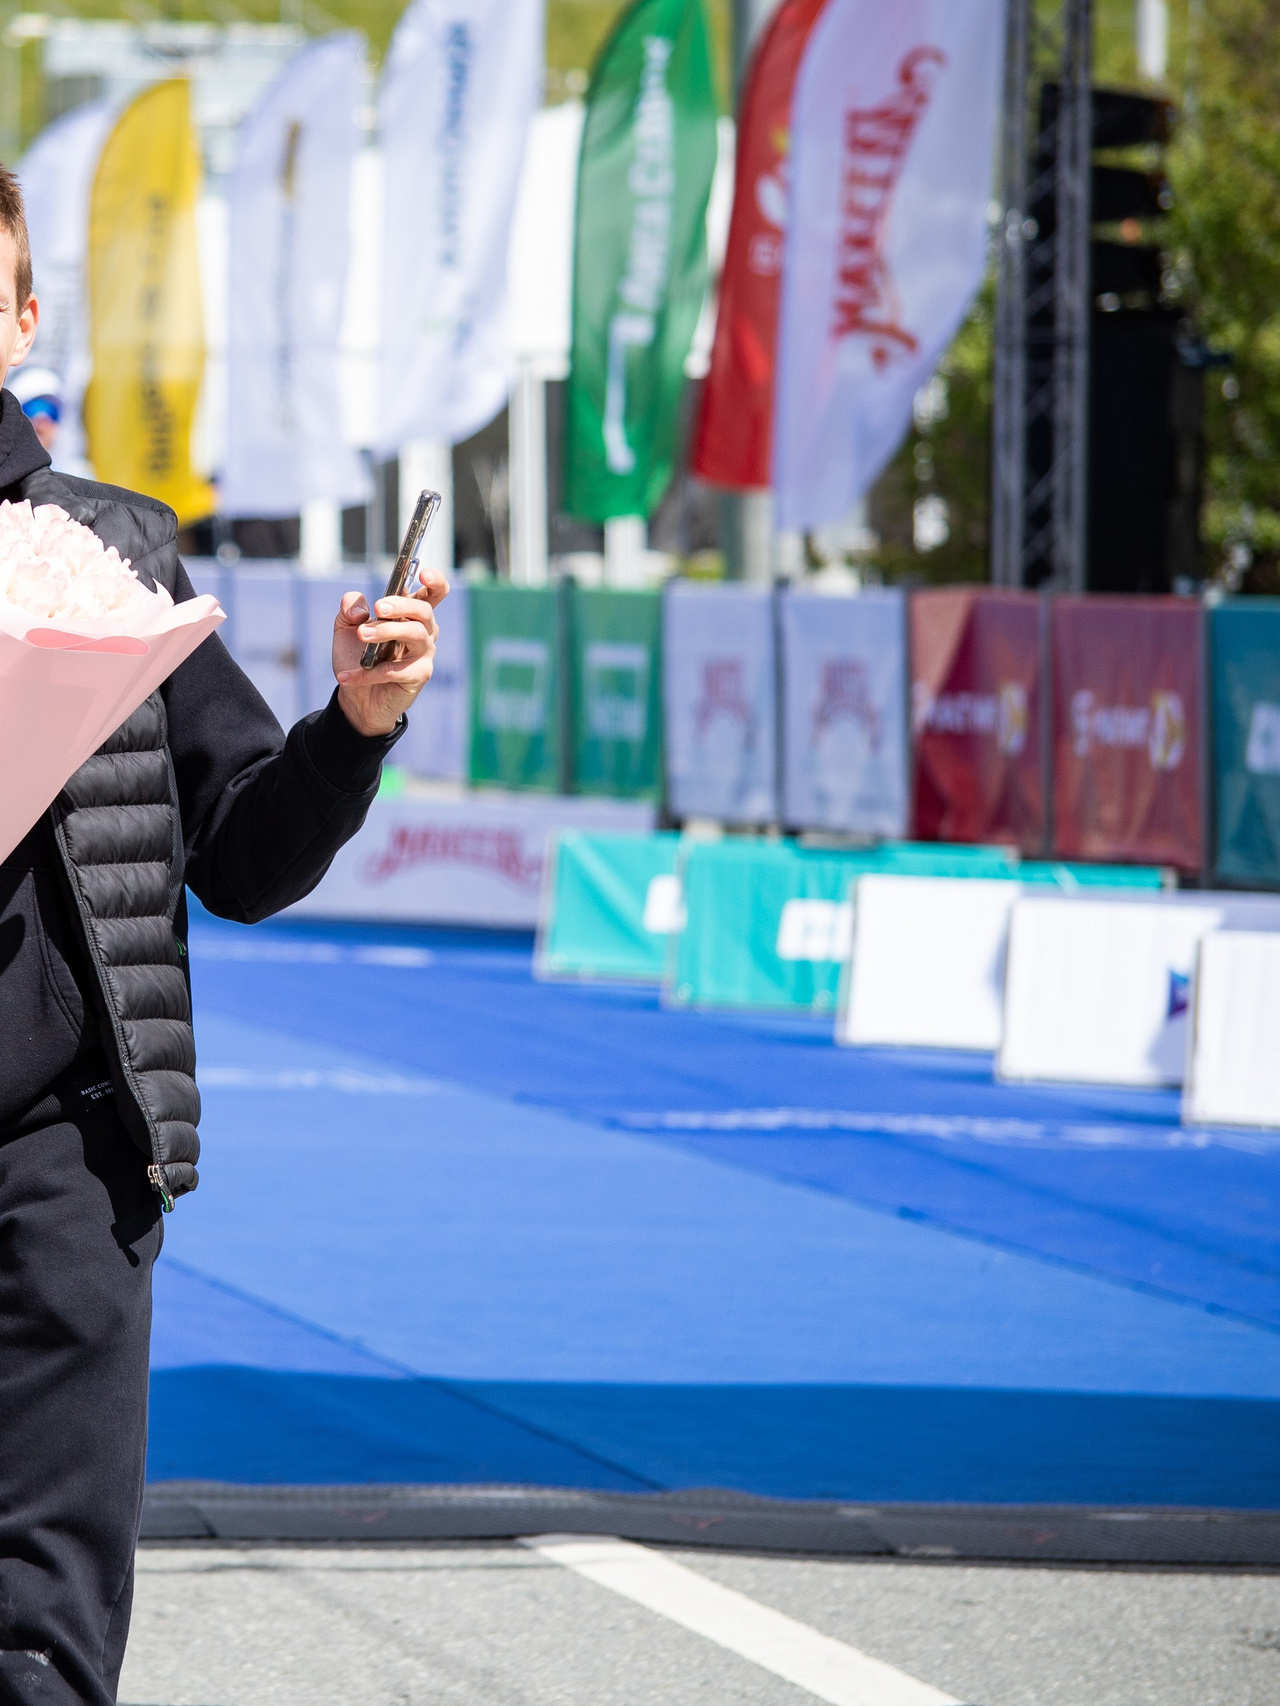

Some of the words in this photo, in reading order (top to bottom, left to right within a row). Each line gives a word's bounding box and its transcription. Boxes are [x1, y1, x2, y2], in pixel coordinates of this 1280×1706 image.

[81, 1086, 97, 1095] BASIC
[97, 1080, 112, 1089] CONC
[91, 1091, 105, 1100] EST.
